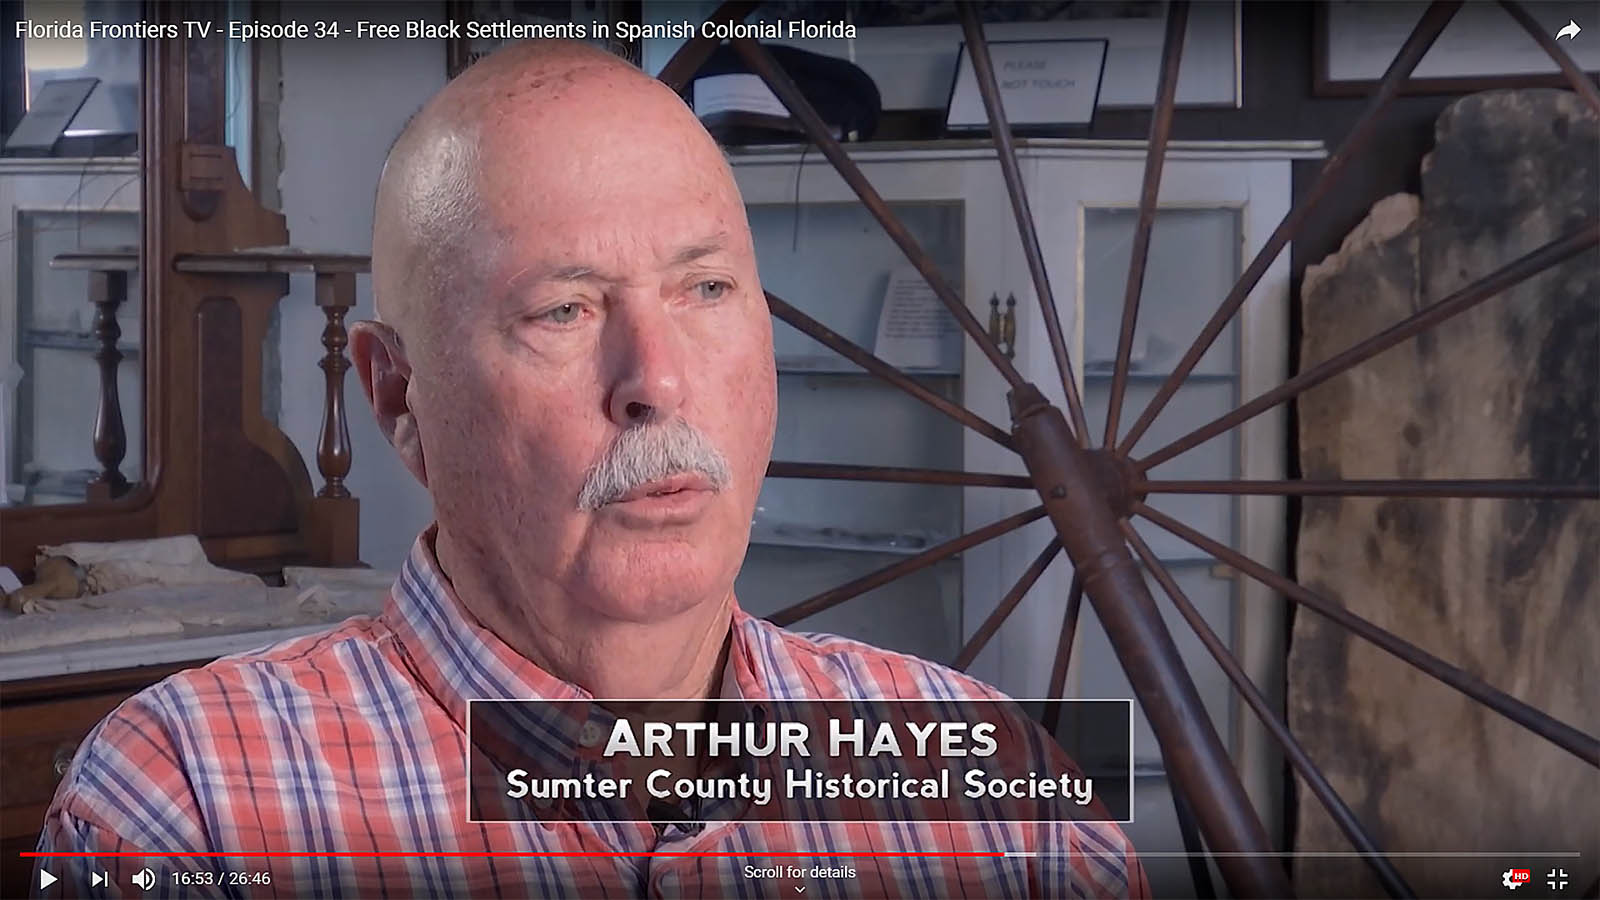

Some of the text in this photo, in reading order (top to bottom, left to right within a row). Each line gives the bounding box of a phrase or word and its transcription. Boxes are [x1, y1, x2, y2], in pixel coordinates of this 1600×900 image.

[1003, 60, 1048, 71] PLEASE
[1001, 79, 1076, 89] NOT TOUCH
